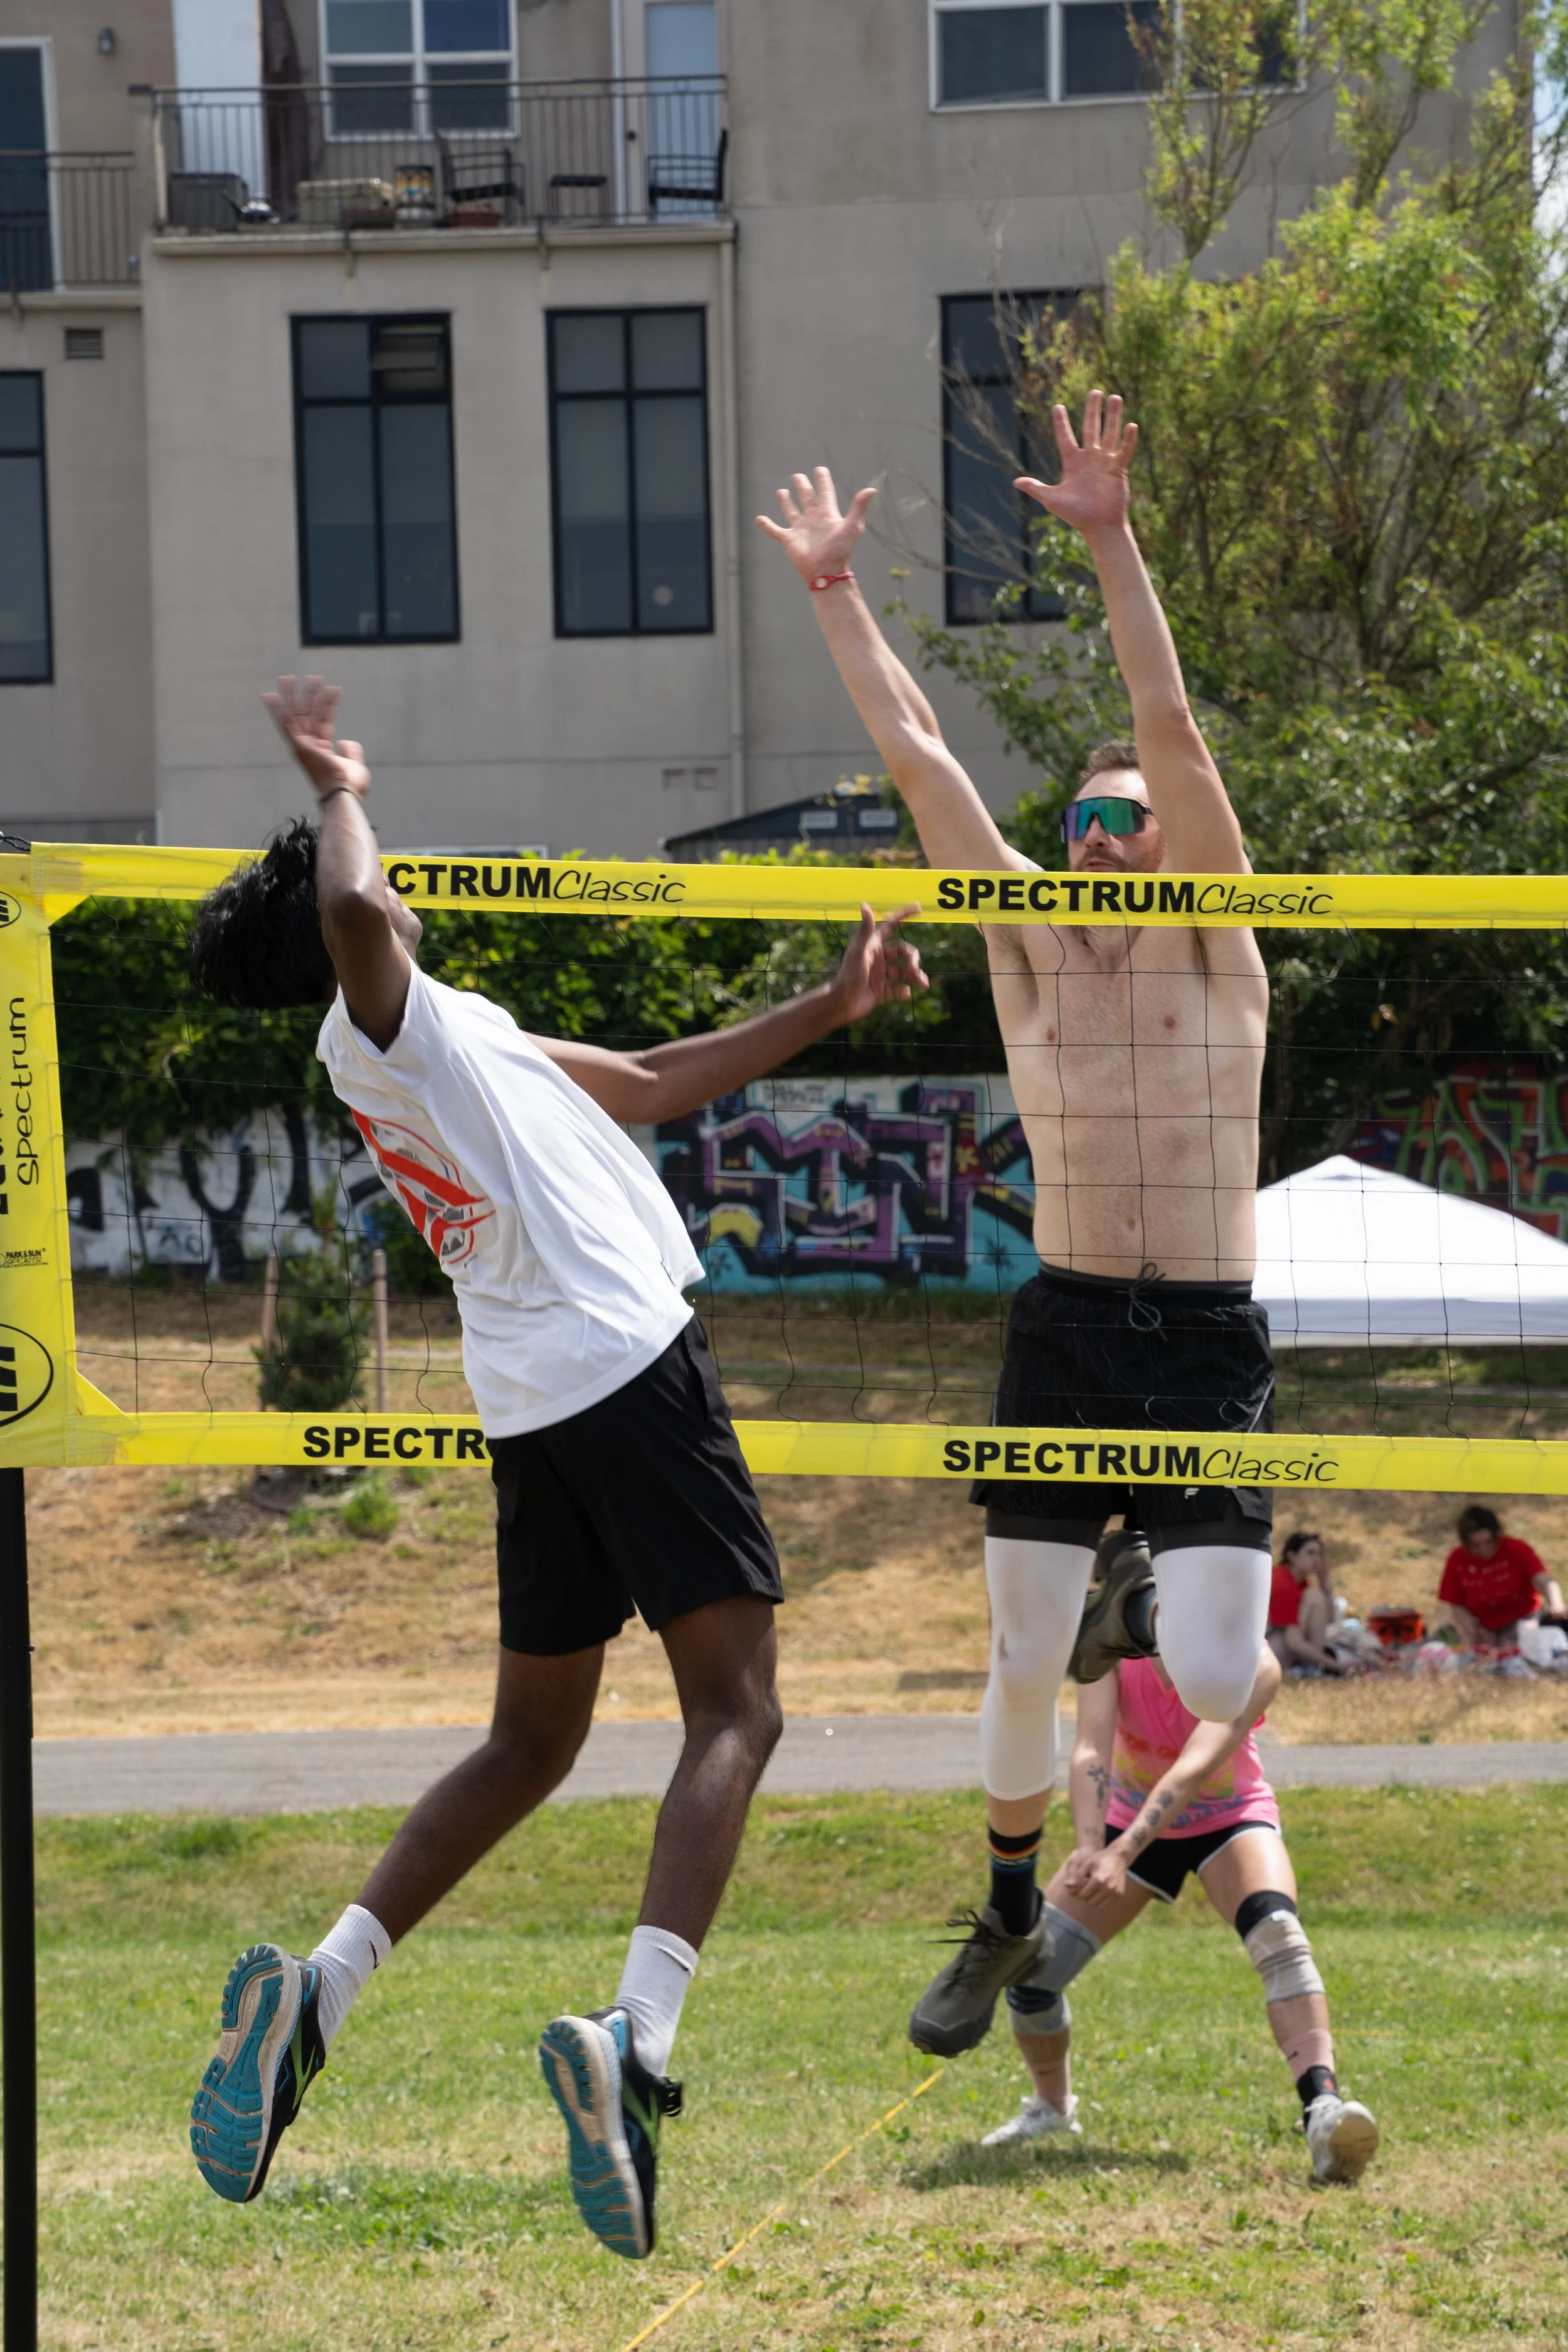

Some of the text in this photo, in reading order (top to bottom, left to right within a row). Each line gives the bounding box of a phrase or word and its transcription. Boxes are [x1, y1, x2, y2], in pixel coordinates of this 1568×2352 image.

[388, 863, 686, 903] CTRUM Classic
[938, 878, 1333, 914] SPECTRUM Classic
[304, 1426, 485, 1459] SPECTR
[943, 1440, 1338, 1481] SPECTRUM Classic
